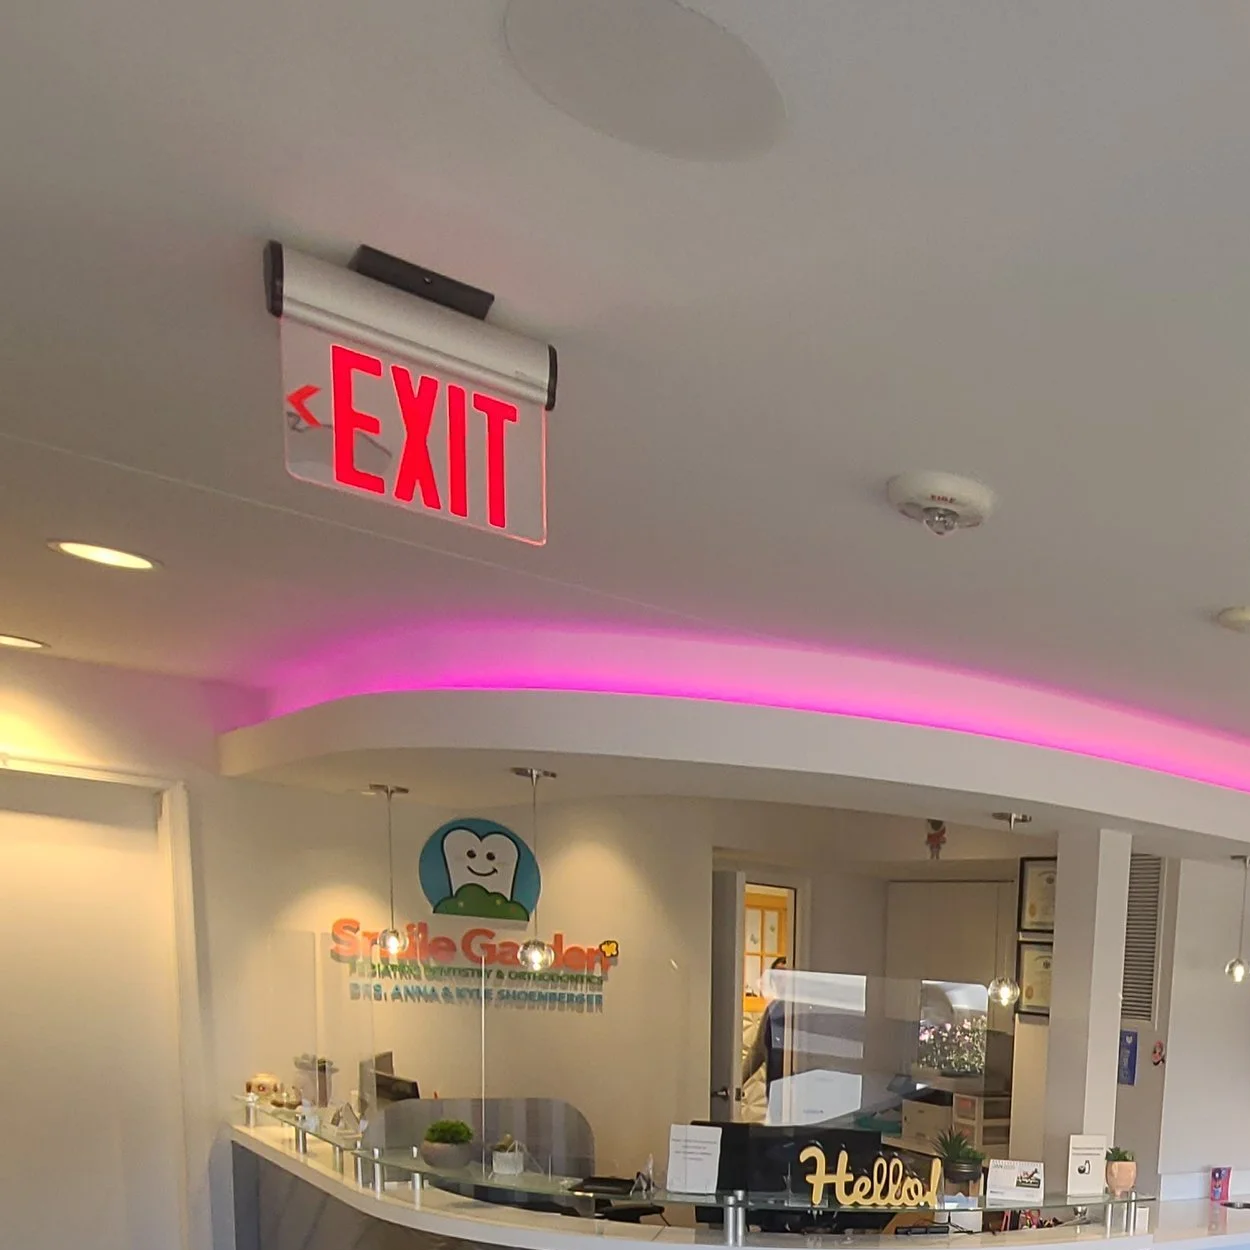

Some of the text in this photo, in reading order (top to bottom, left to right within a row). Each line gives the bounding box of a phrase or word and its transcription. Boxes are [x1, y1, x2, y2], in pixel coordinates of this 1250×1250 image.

[330, 344, 519, 528] EXIT
[461, 928, 612, 973] Gaden
[391, 985, 440, 1001] ANNA
[456, 988, 493, 1002] KYLE
[508, 970, 603, 984] ORTHODONTICS
[800, 1146, 942, 1208] Hello!
